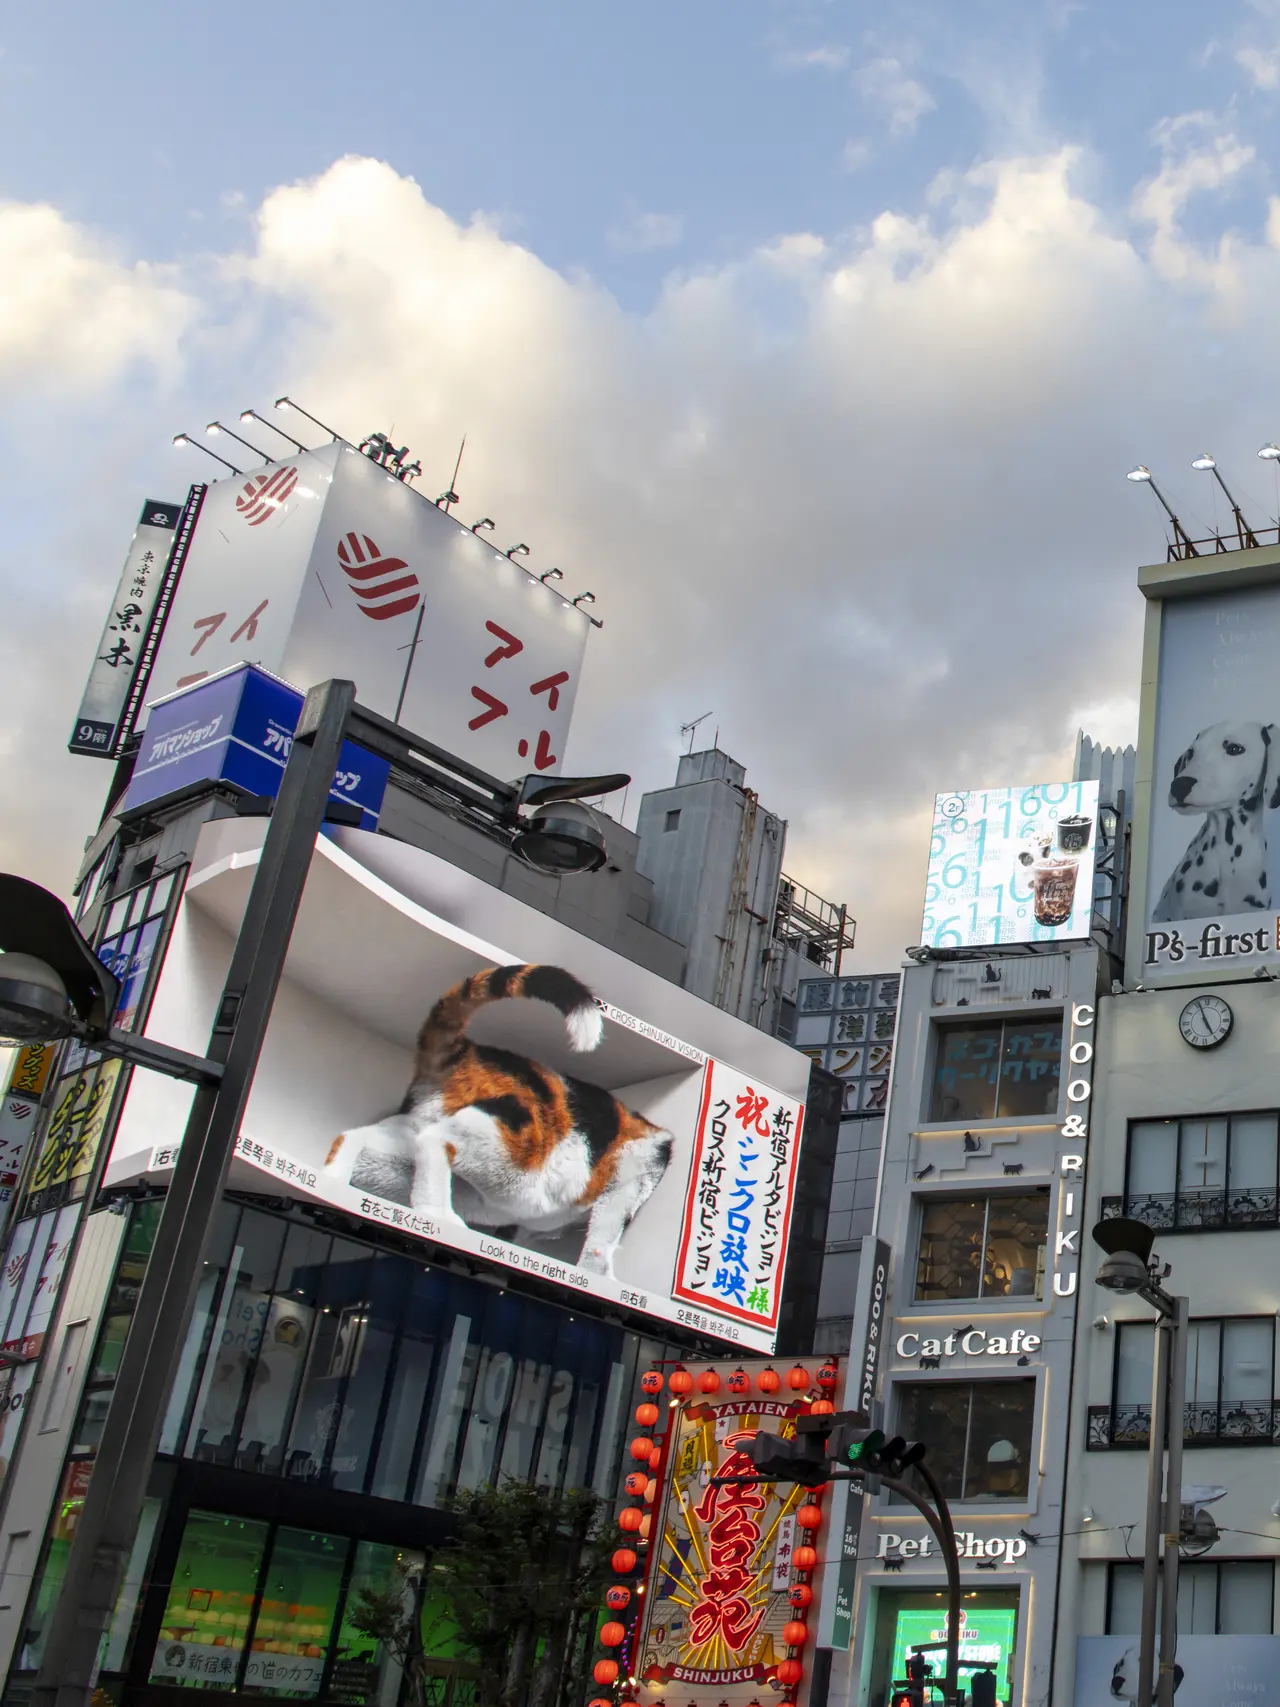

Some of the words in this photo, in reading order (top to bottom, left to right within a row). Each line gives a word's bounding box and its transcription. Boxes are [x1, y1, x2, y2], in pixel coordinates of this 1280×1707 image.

[98, 603, 143, 668] 黒木
[610, 1008, 637, 1029] CROSS
[639, 1022, 676, 1049] SHINJUKU
[678, 1043, 703, 1062] VISION
[735, 1086, 771, 1138] 祝
[691, 1099, 732, 1290] クロス新宿ビジョン
[360, 1197, 442, 1236] 右をご覧ください
[712, 1136, 759, 1307] シンクロ放映
[479, 1239, 506, 1259] Look
[508, 1250, 520, 1264] to
[522, 1255, 540, 1271] the
[541, 1261, 568, 1282] right
[569, 1272, 590, 1288] side
[620, 1288, 649, 1310] 向右看
[676, 1308, 708, 1330] 오른쪽을
[896, 1333, 957, 1358] Cat
[961, 1329, 1041, 1356] Cafe
[713, 1402, 789, 1419] YATAIEN
[876, 1533, 933, 1559] Pet
[836, 1606, 851, 1620] Shop
[837, 1594, 848, 1607] Pet
[673, 1666, 755, 1683] SHINJUKU
